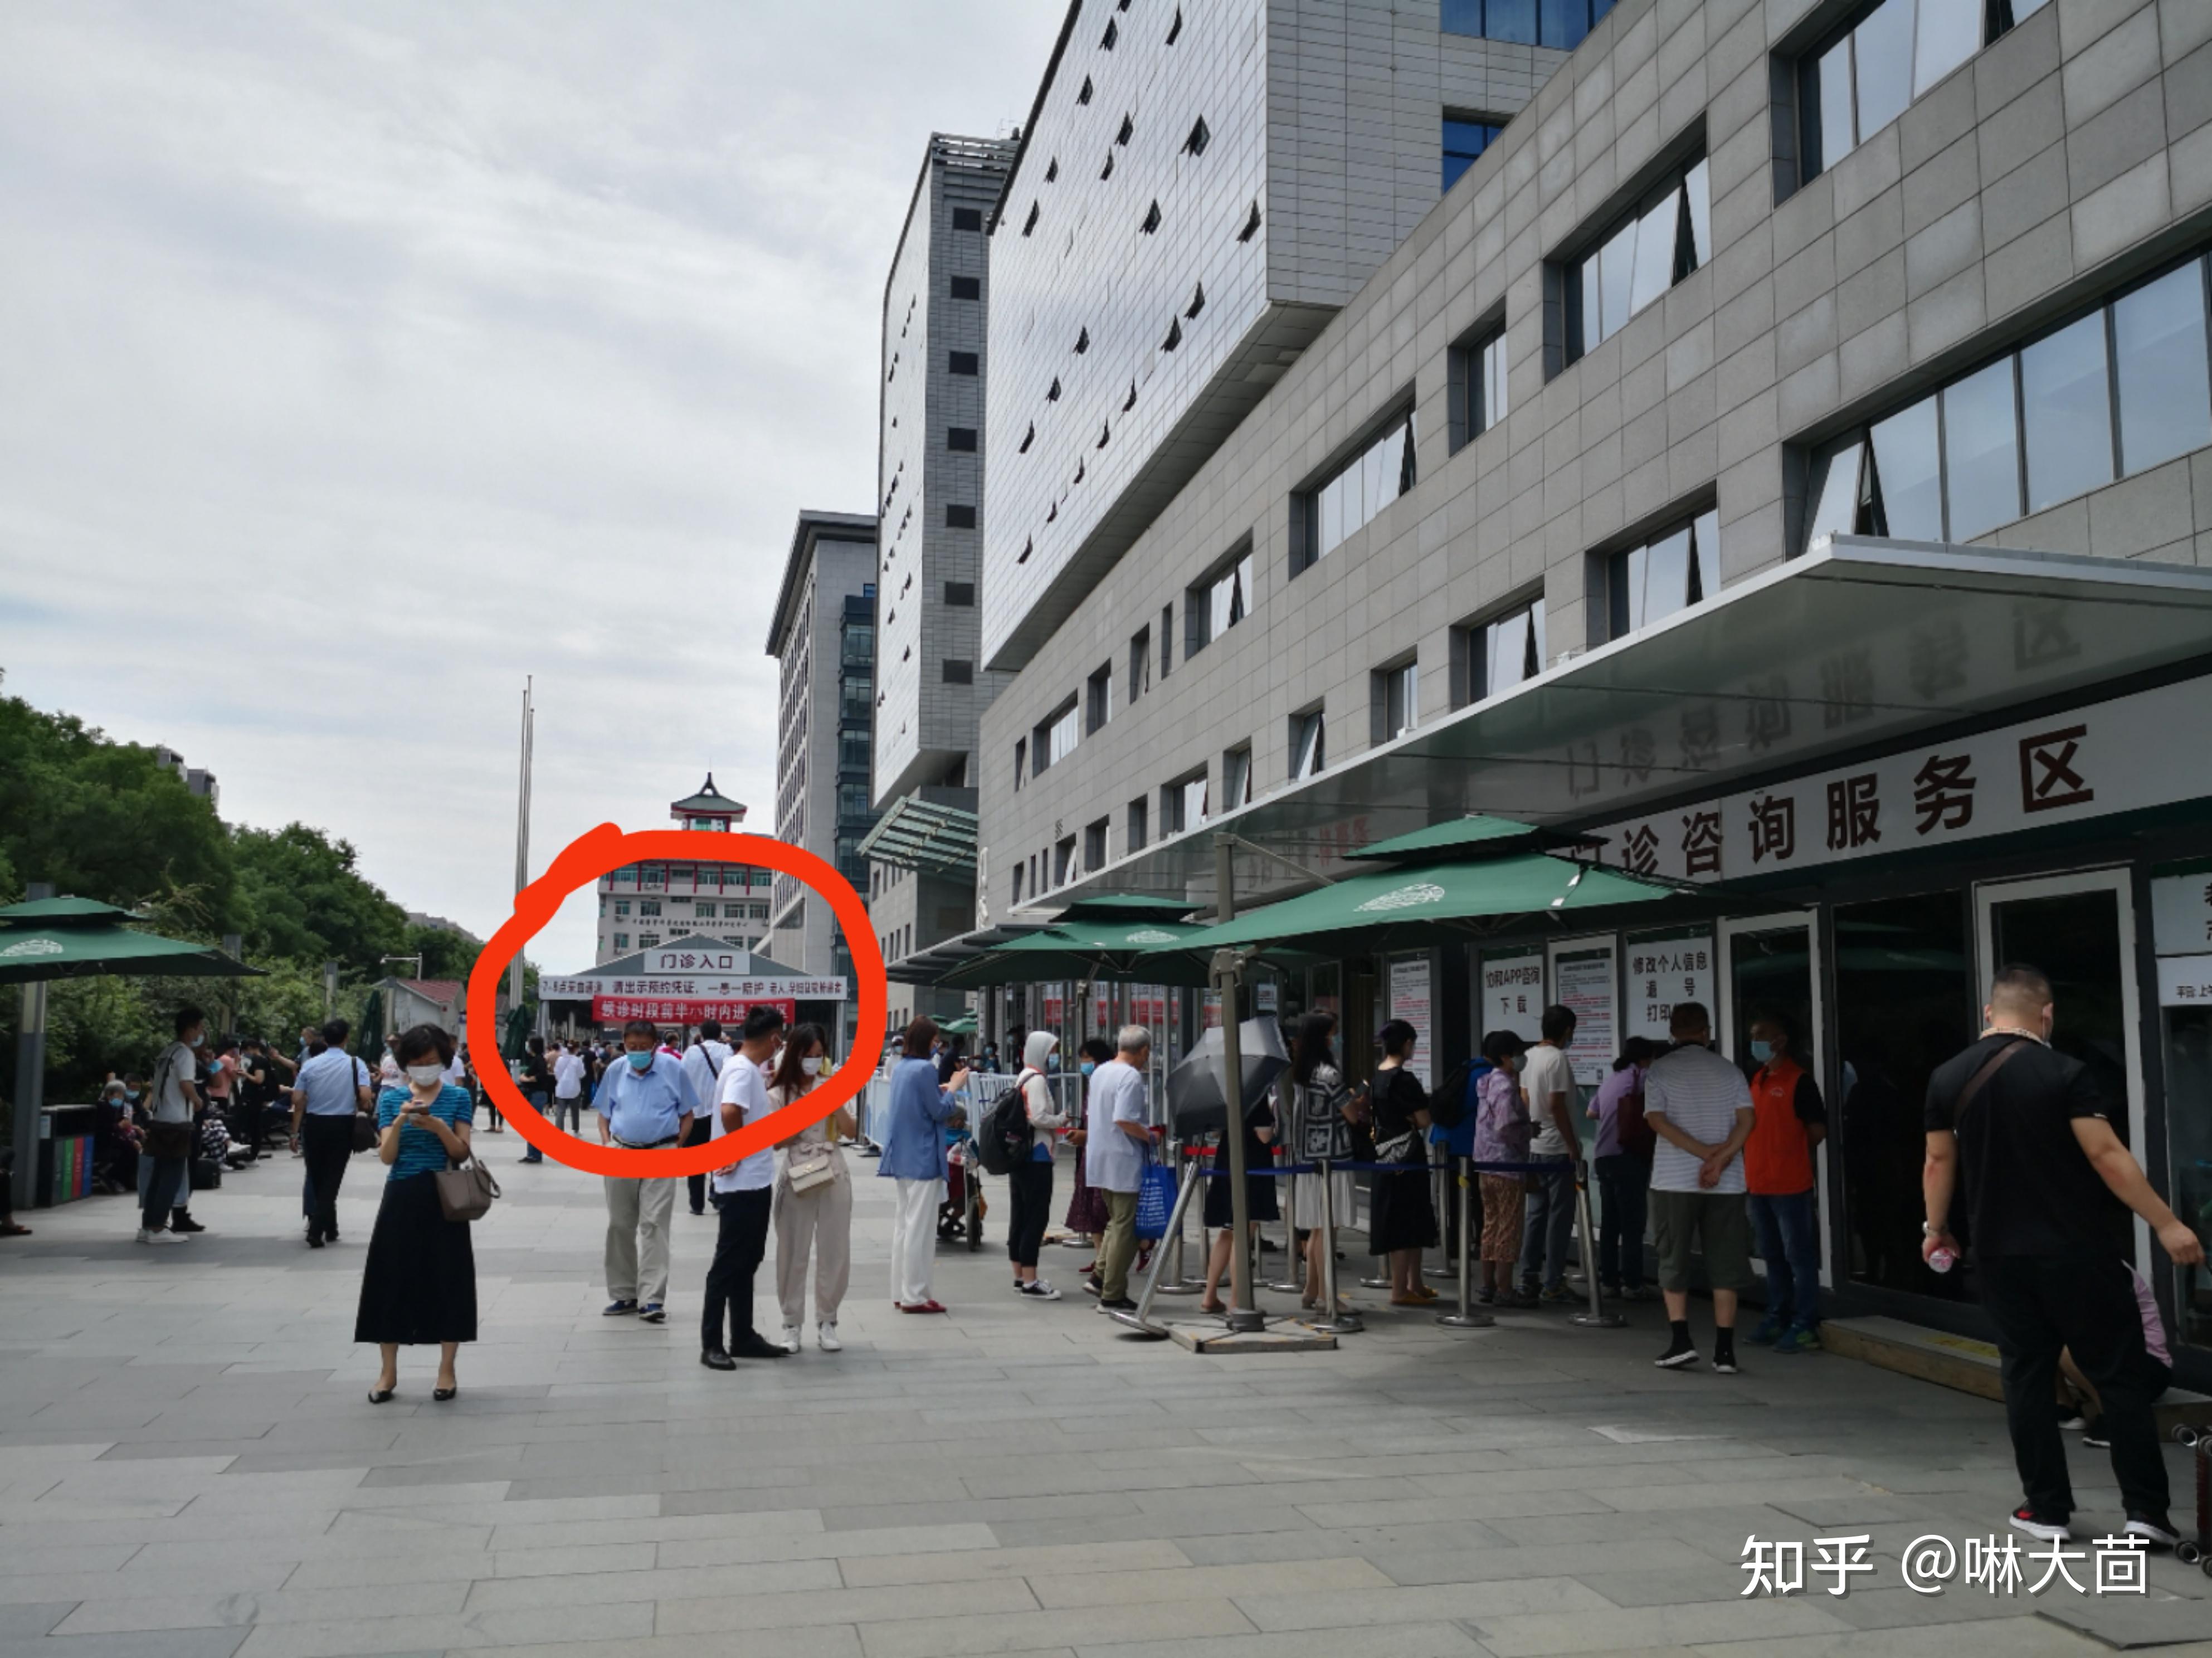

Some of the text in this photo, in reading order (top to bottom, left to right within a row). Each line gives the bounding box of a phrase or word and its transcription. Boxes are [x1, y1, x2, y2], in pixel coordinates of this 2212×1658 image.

[660, 954, 733, 969] 门诊入口
[1633, 950, 1708, 976] 修改个人信息
[1646, 1003, 1675, 1022] 打印
